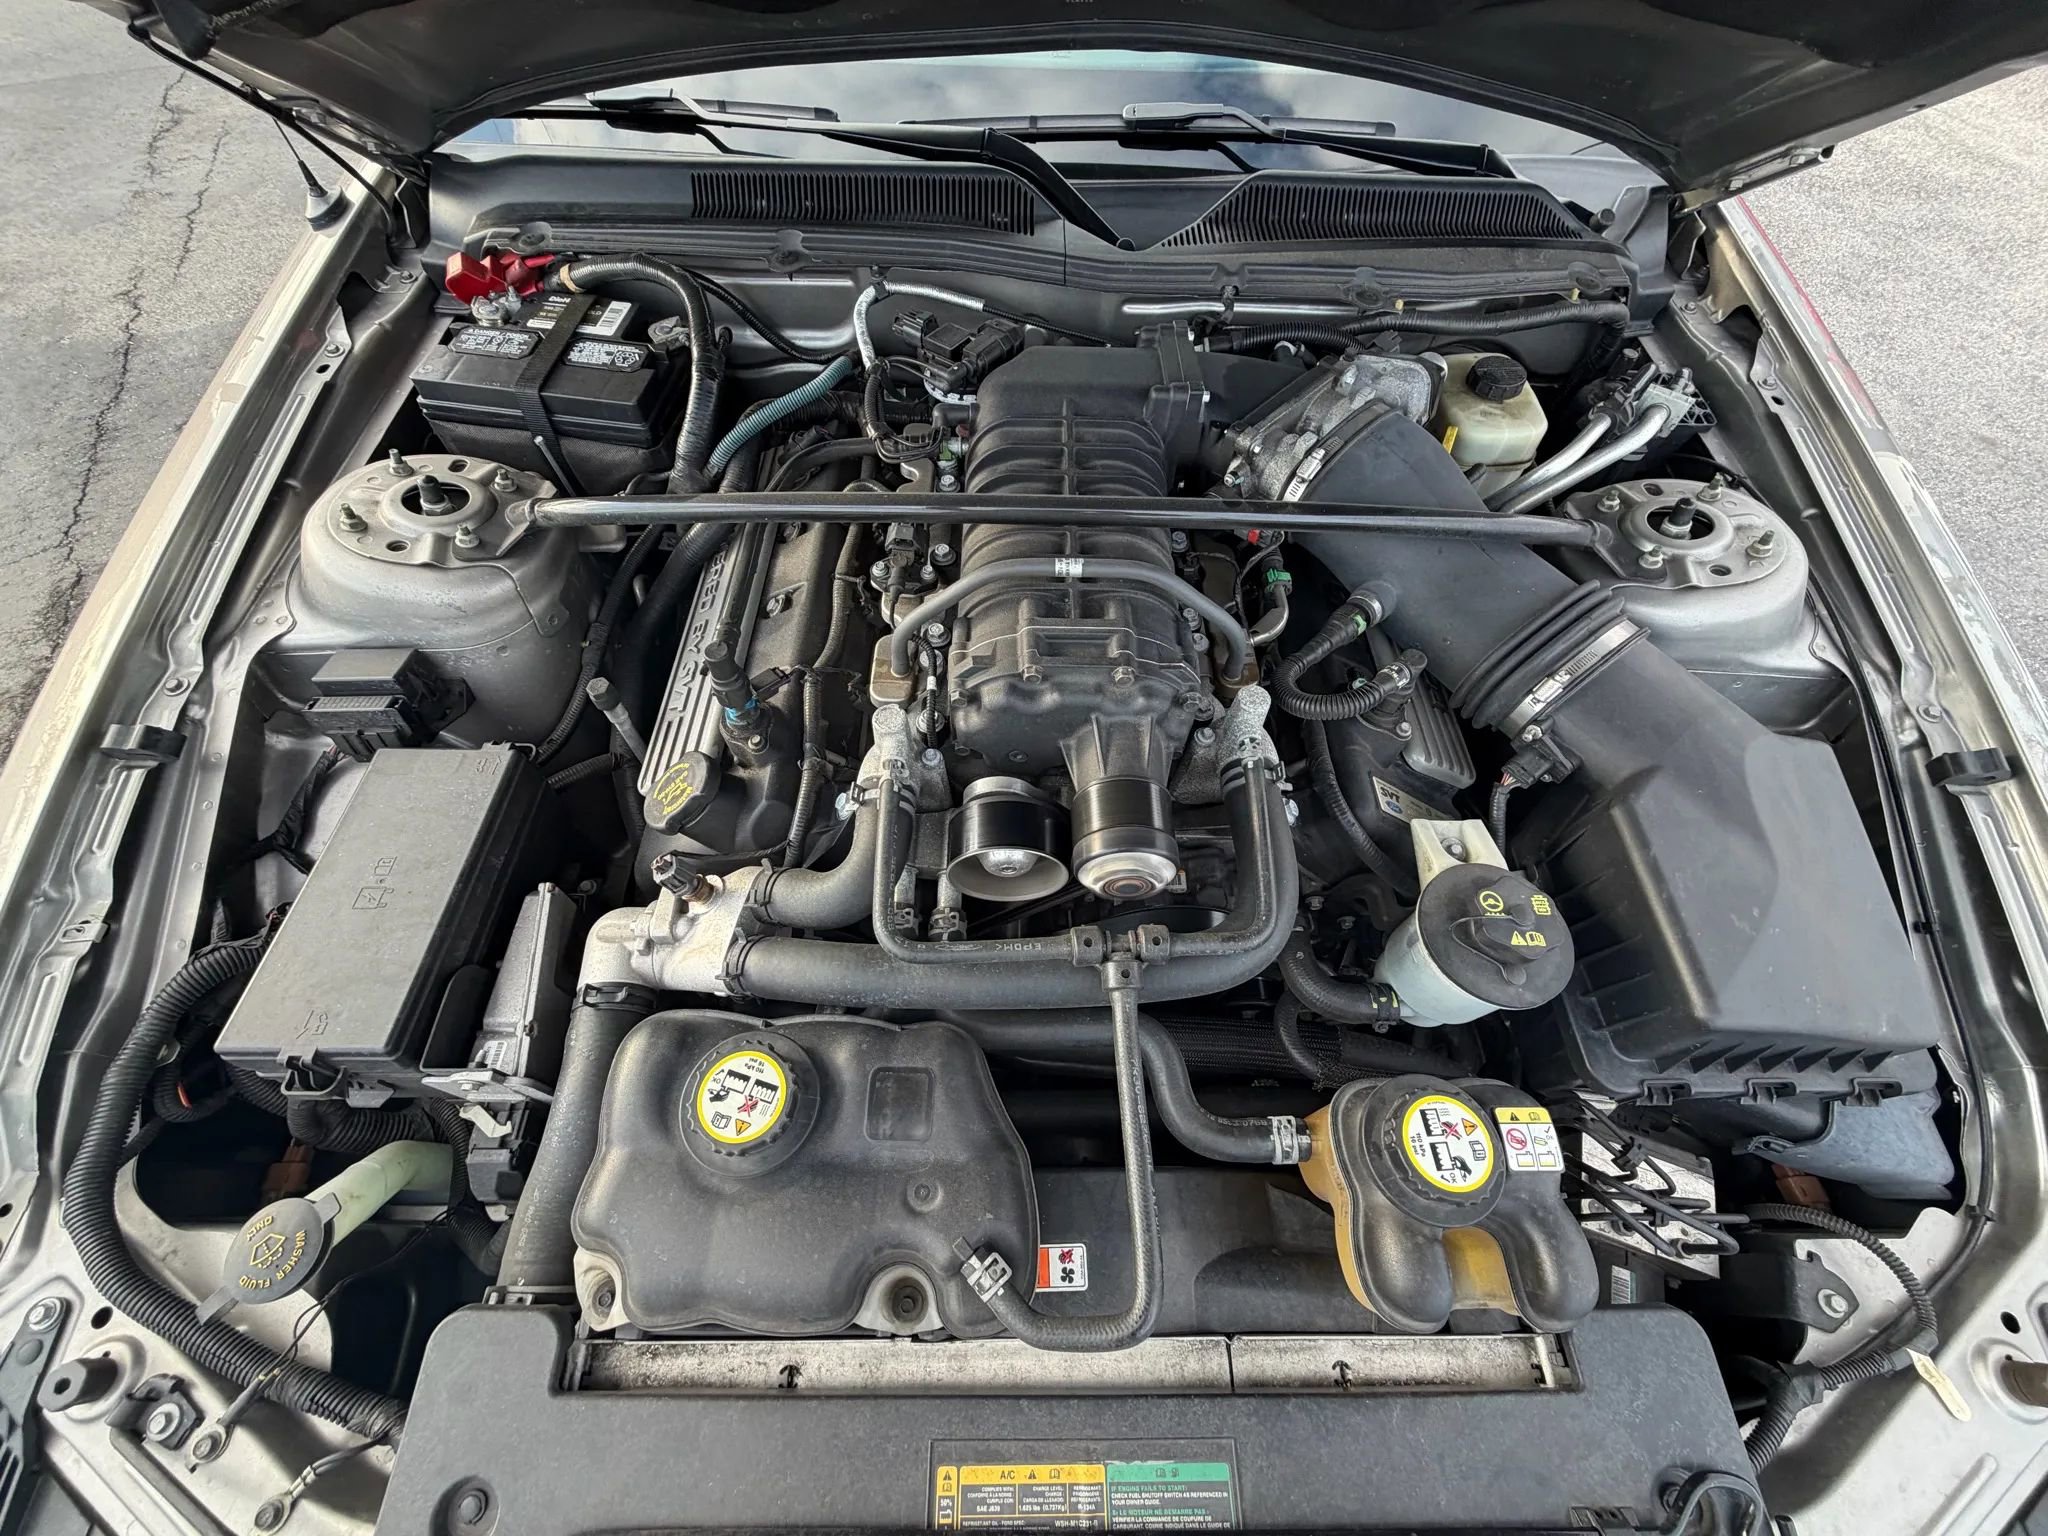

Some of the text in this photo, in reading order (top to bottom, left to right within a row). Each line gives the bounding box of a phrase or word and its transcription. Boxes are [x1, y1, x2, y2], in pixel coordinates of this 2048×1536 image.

[688, 619, 709, 654] BY
[668, 660, 698, 714] SVT
[1380, 786, 1400, 803] SVT
[1450, 1172, 1457, 1183] OK
[246, 1215, 273, 1241] ONLY
[239, 1230, 307, 1290] WASHER FLUID
[1000, 1470, 1016, 1480] A/C
